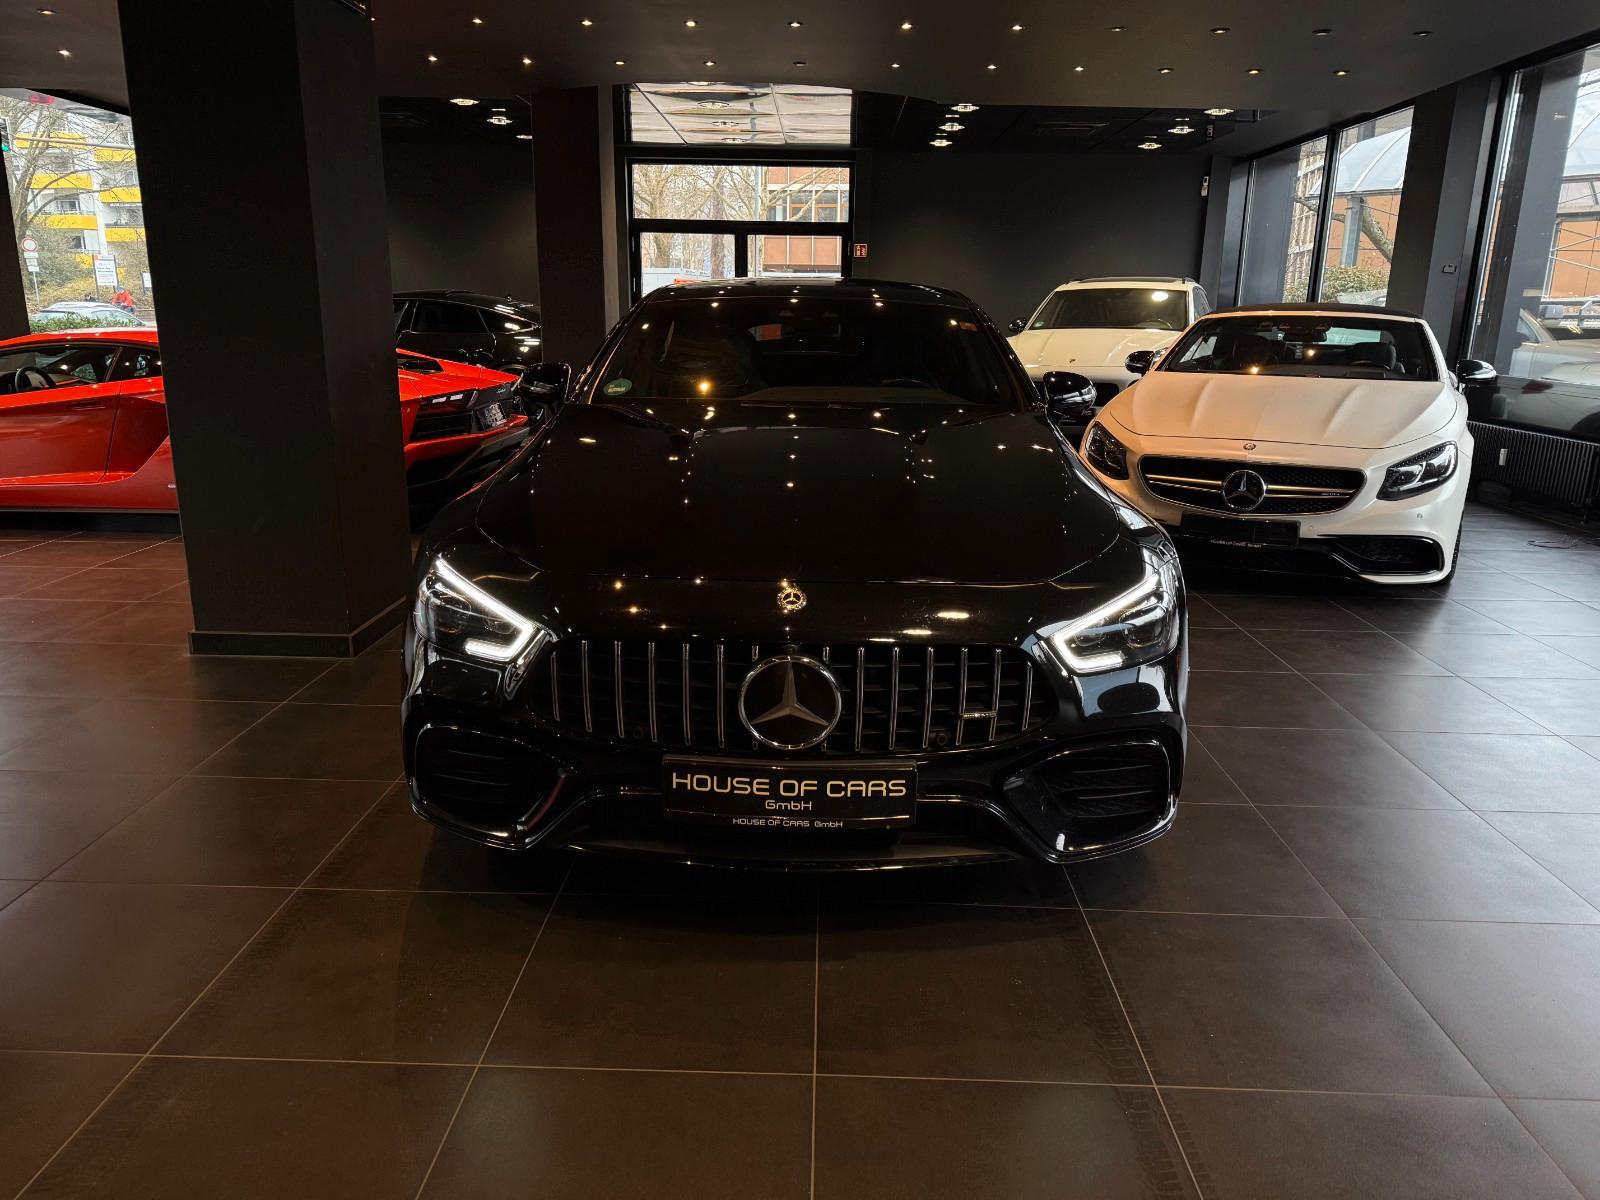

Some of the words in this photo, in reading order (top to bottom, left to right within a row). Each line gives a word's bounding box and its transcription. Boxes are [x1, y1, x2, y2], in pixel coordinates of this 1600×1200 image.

[672, 772, 770, 796] HOUSE
[779, 779, 818, 797] OF
[826, 779, 907, 798] CARS
[764, 799, 812, 811] GmbH
[732, 817, 766, 826] HOUSE
[768, 819, 781, 827] OF
[783, 819, 810, 828] CARS
[814, 820, 843, 828] GmbH
